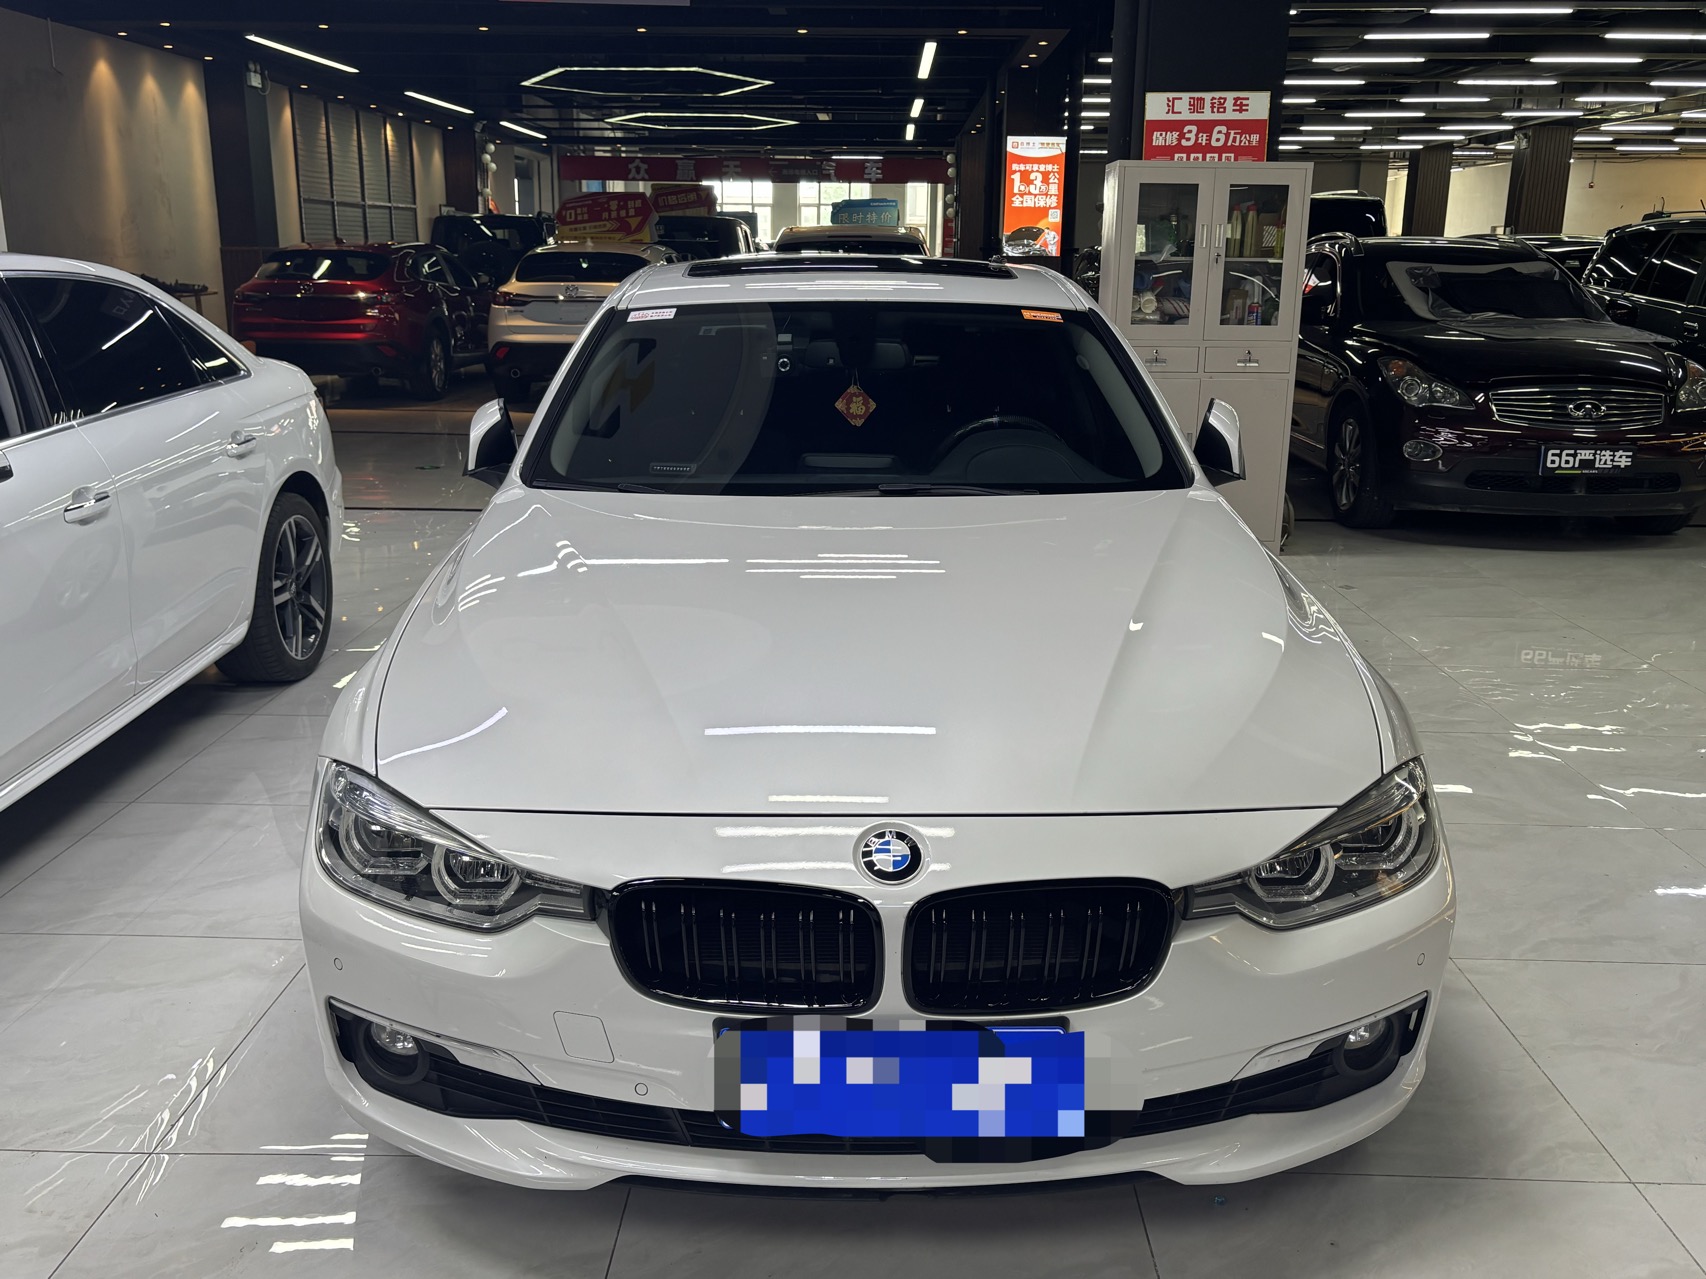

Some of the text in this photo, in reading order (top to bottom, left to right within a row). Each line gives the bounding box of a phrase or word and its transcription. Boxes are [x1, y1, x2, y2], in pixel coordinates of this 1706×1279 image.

[1166, 96, 1250, 114] 汇驰铭车
[1152, 125, 1260, 147] 保修3年6万公里
[1011, 163, 1060, 172] 购车可享查博士
[1011, 195, 1059, 208] 全国保修
[838, 211, 893, 224] 限时特价
[1546, 449, 1633, 468] 66严选车
[866, 830, 917, 847] BMW
